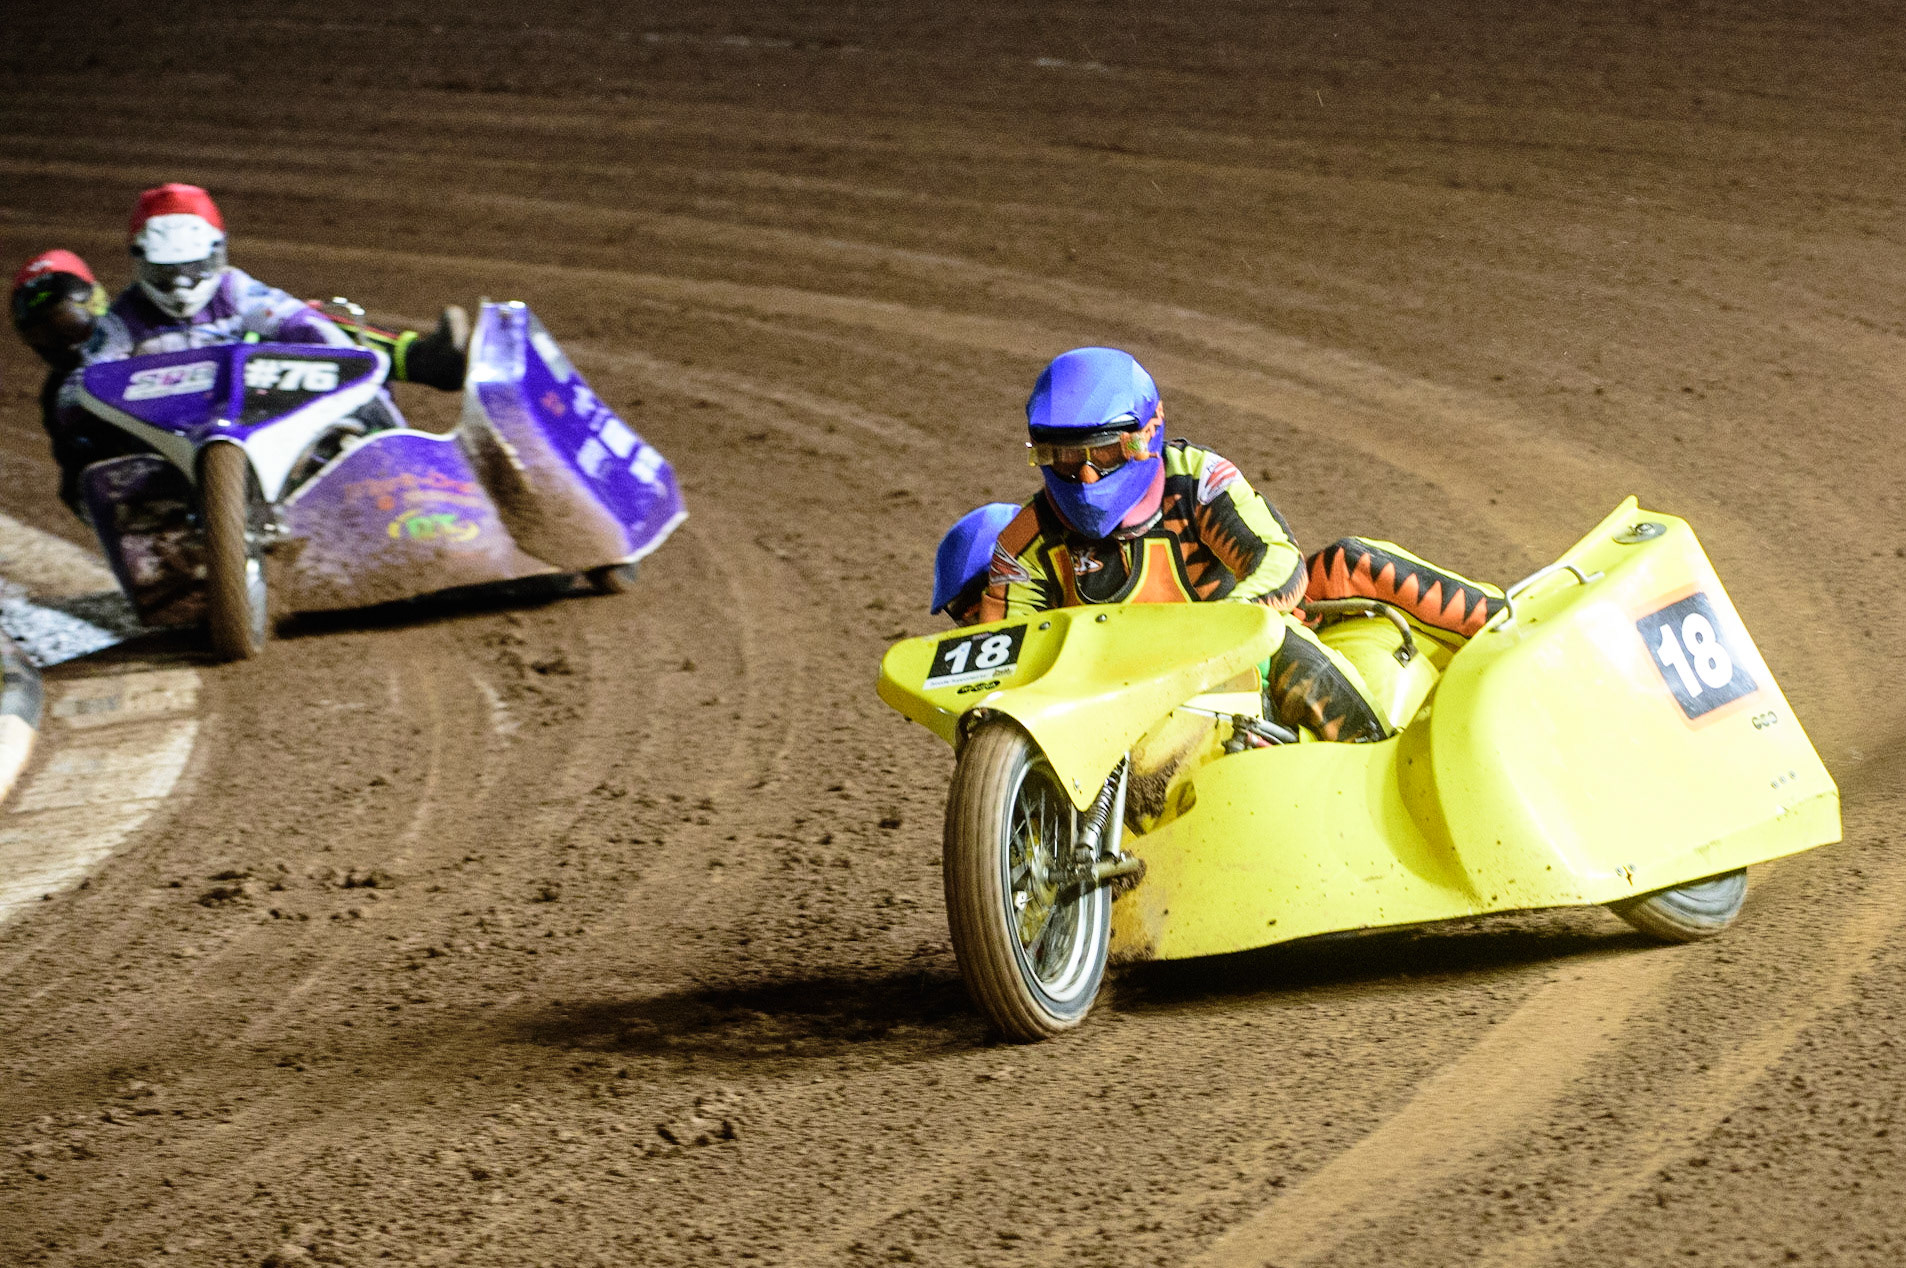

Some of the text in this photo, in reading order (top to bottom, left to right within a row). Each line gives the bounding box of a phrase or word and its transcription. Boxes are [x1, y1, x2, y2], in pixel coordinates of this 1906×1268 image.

[243, 358, 340, 392] #76
[944, 634, 1013, 675] 18
[1657, 612, 1734, 698] 18
